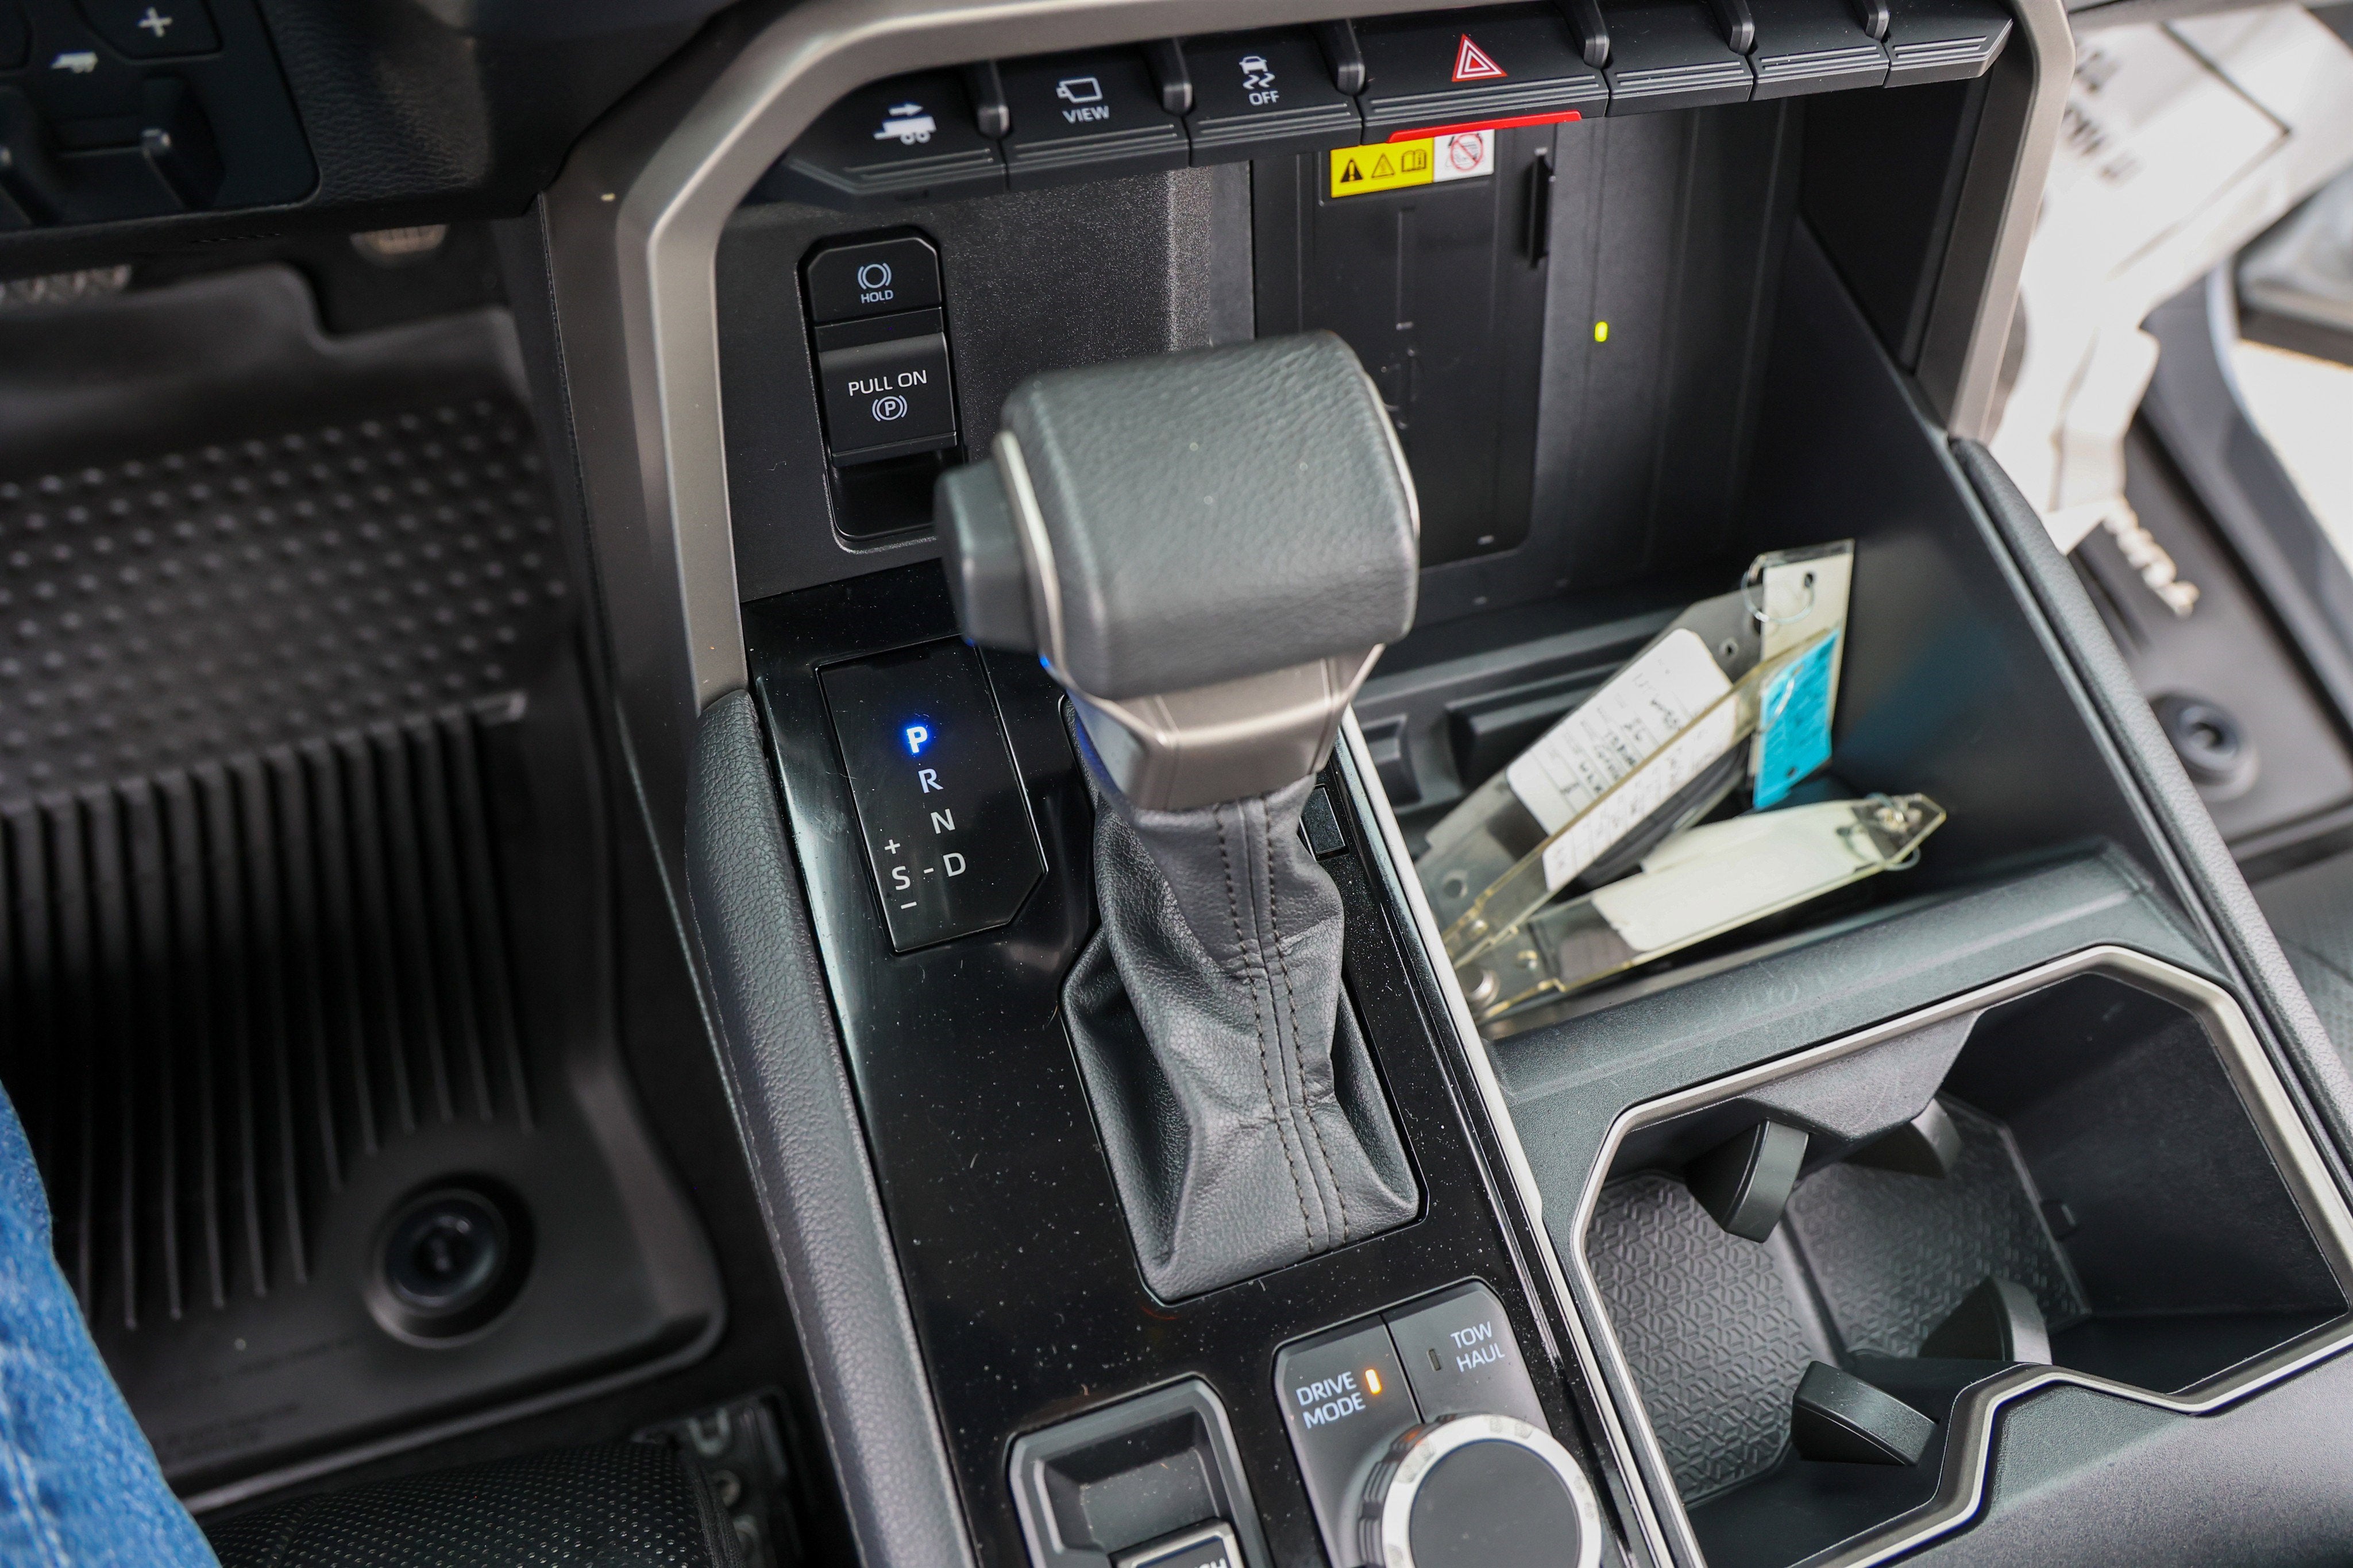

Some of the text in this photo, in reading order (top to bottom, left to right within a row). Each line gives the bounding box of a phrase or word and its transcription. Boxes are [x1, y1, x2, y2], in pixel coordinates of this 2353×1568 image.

[1248, 90, 1280, 106] OFF
[1062, 105, 1110, 123] VIEW
[861, 289, 894, 304] HOLD
[848, 369, 927, 397] PULL ON
[906, 725, 928, 754] P
[918, 768, 944, 794] R
[930, 808, 955, 834] N
[891, 866, 911, 890] S
[943, 852, 966, 877] D
[1449, 1320, 1492, 1349] TOW
[1455, 1342, 1505, 1373] HAUL
[1295, 1370, 1357, 1406] DRIVE
[1302, 1391, 1367, 1430] MODE
